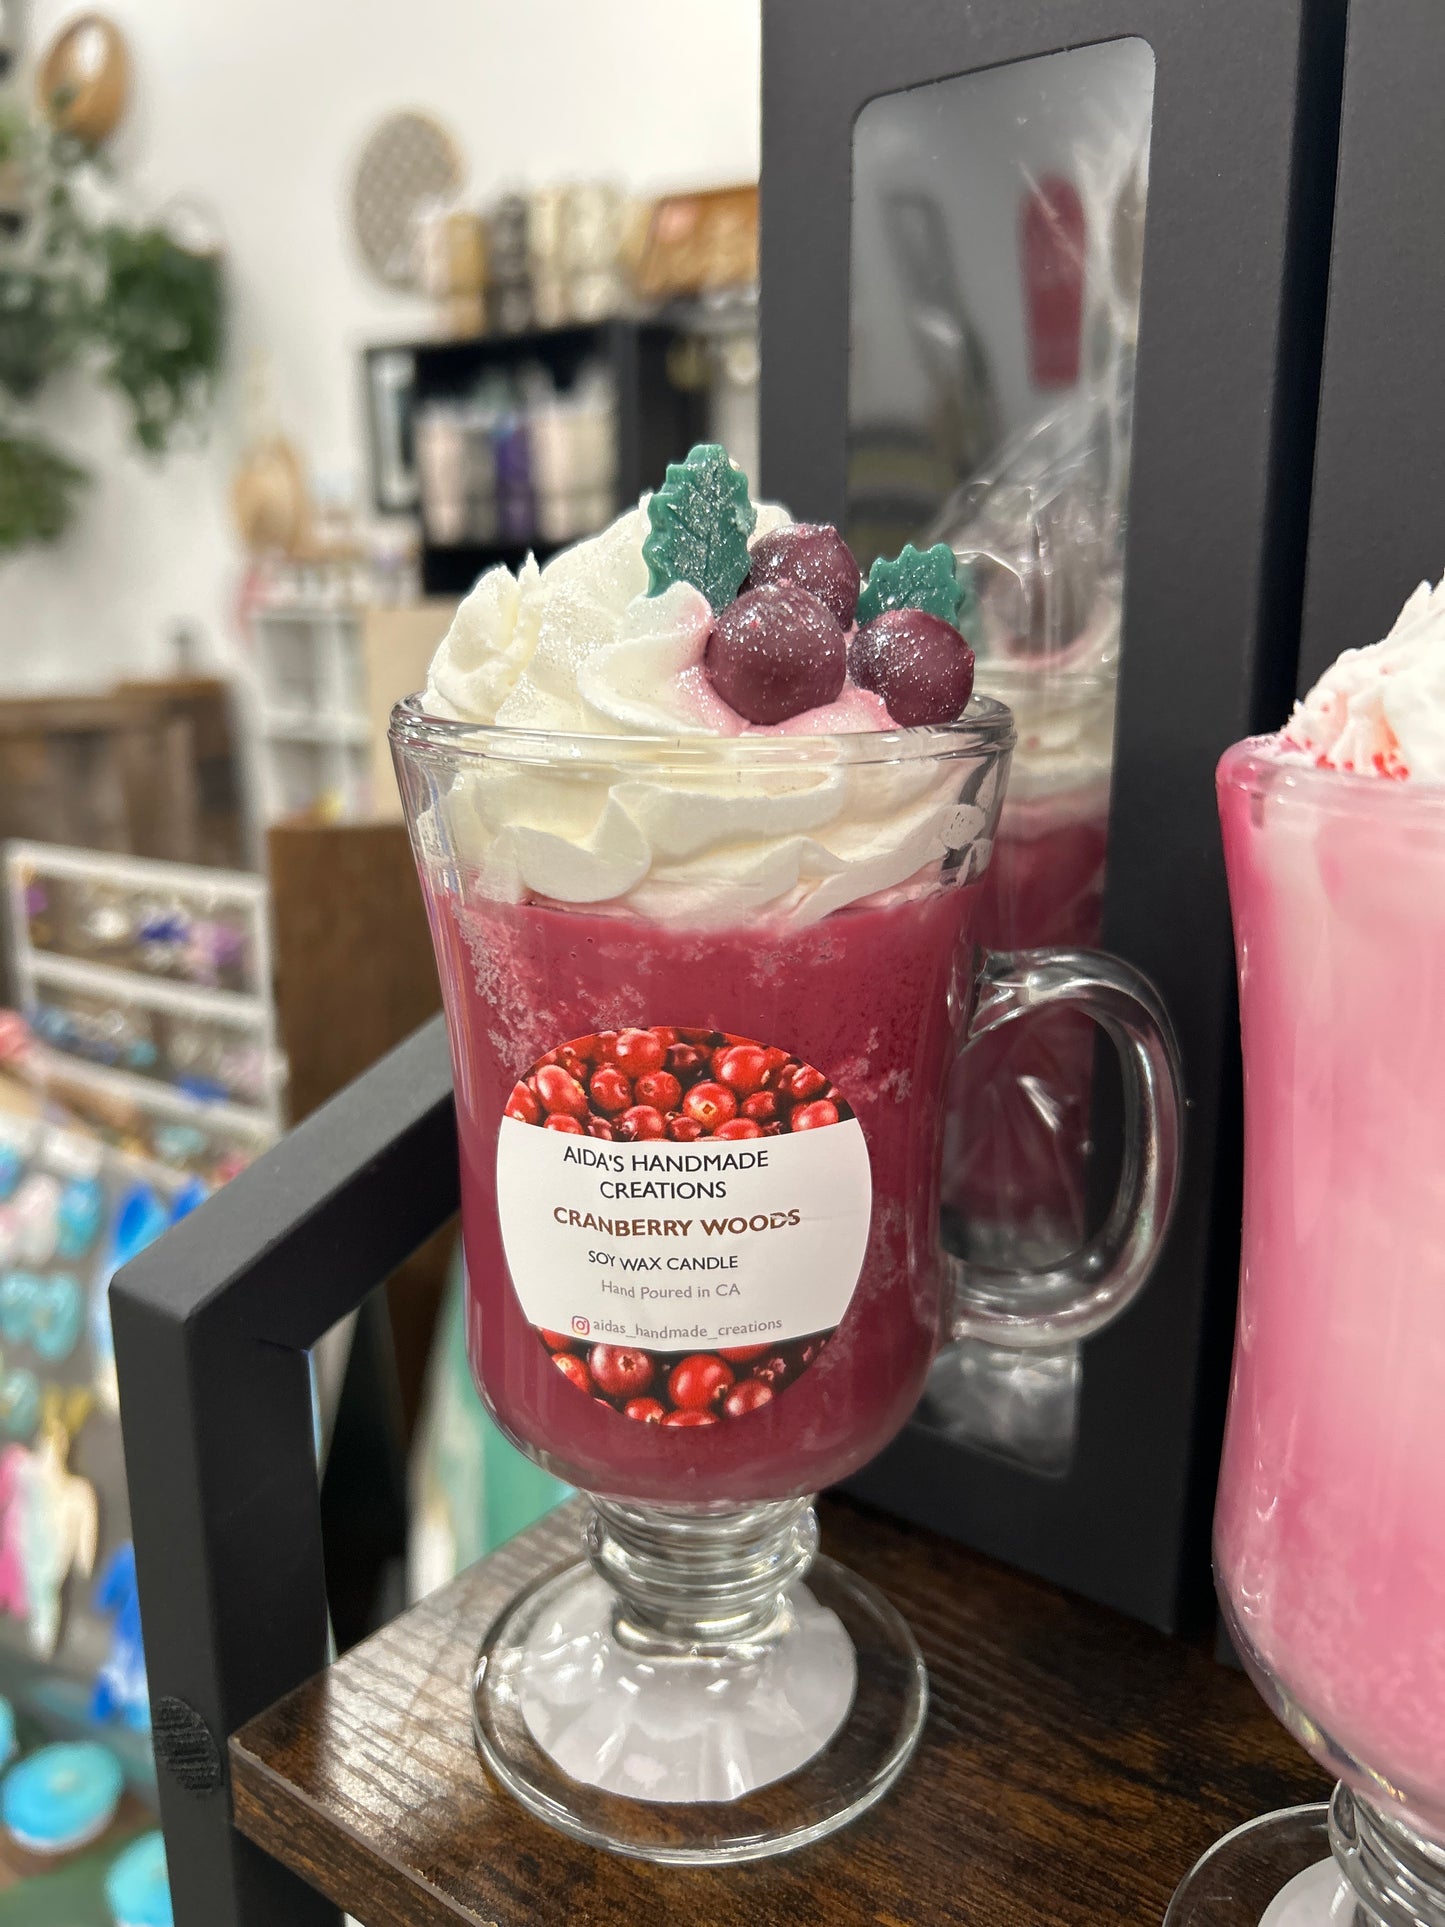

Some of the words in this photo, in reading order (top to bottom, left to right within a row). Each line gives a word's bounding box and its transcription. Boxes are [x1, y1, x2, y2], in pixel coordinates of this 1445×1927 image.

[563, 1146, 624, 1172] AIDA'S
[632, 1150, 769, 1172] HANDMADE
[600, 1181, 727, 1199] CREATIONS
[553, 1206, 693, 1237] CRANBERRY
[700, 1208, 801, 1236] WOODS
[588, 1250, 616, 1267] SOY
[620, 1256, 662, 1271] WAX
[667, 1255, 739, 1271] CANDLE
[601, 1279, 635, 1298] Hand
[640, 1285, 692, 1300] Poured
[698, 1285, 710, 1299] in
[716, 1283, 741, 1297] CA
[593, 1317, 782, 1340] aidas_handmade_creations
